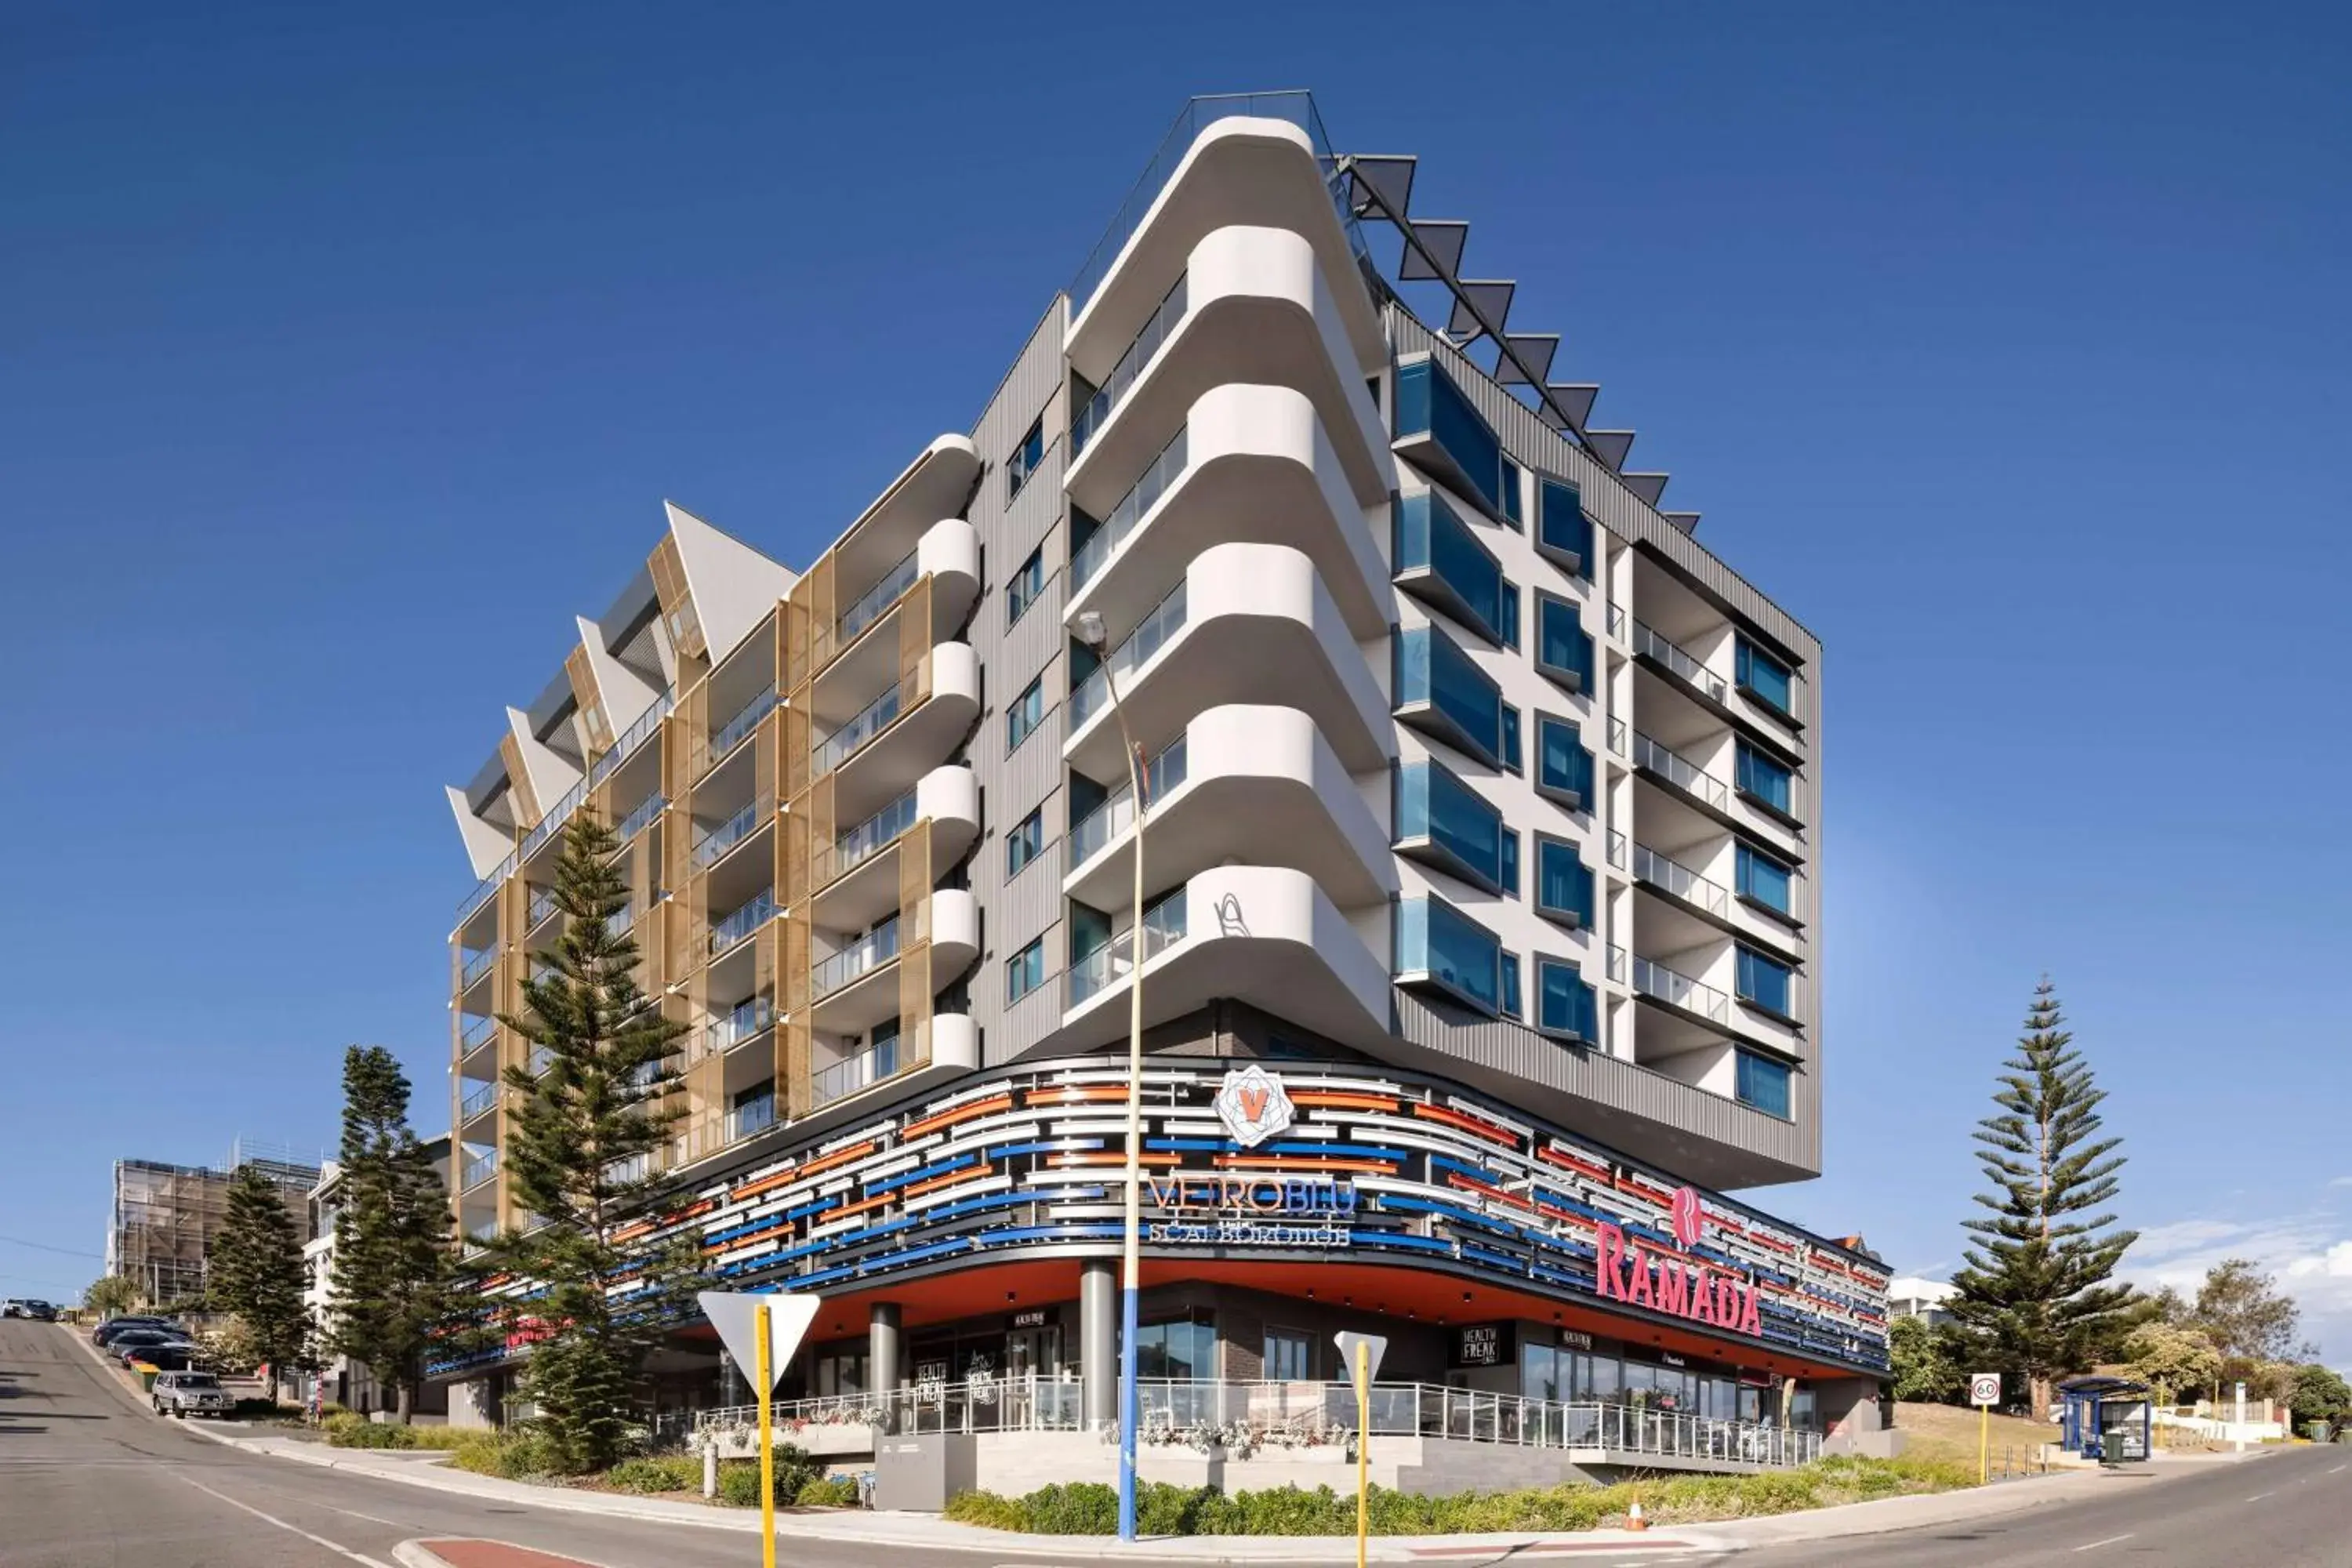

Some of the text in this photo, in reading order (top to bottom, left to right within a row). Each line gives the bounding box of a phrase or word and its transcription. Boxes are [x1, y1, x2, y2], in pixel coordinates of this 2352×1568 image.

[1149, 1225, 1350, 1246] SCARBOROUGH
[1596, 1221, 1762, 1337] RAMADA
[1464, 1328, 1497, 1343] HEALTH
[1464, 1341, 1496, 1358] FREAK
[1977, 1384, 1994, 1394] 60
